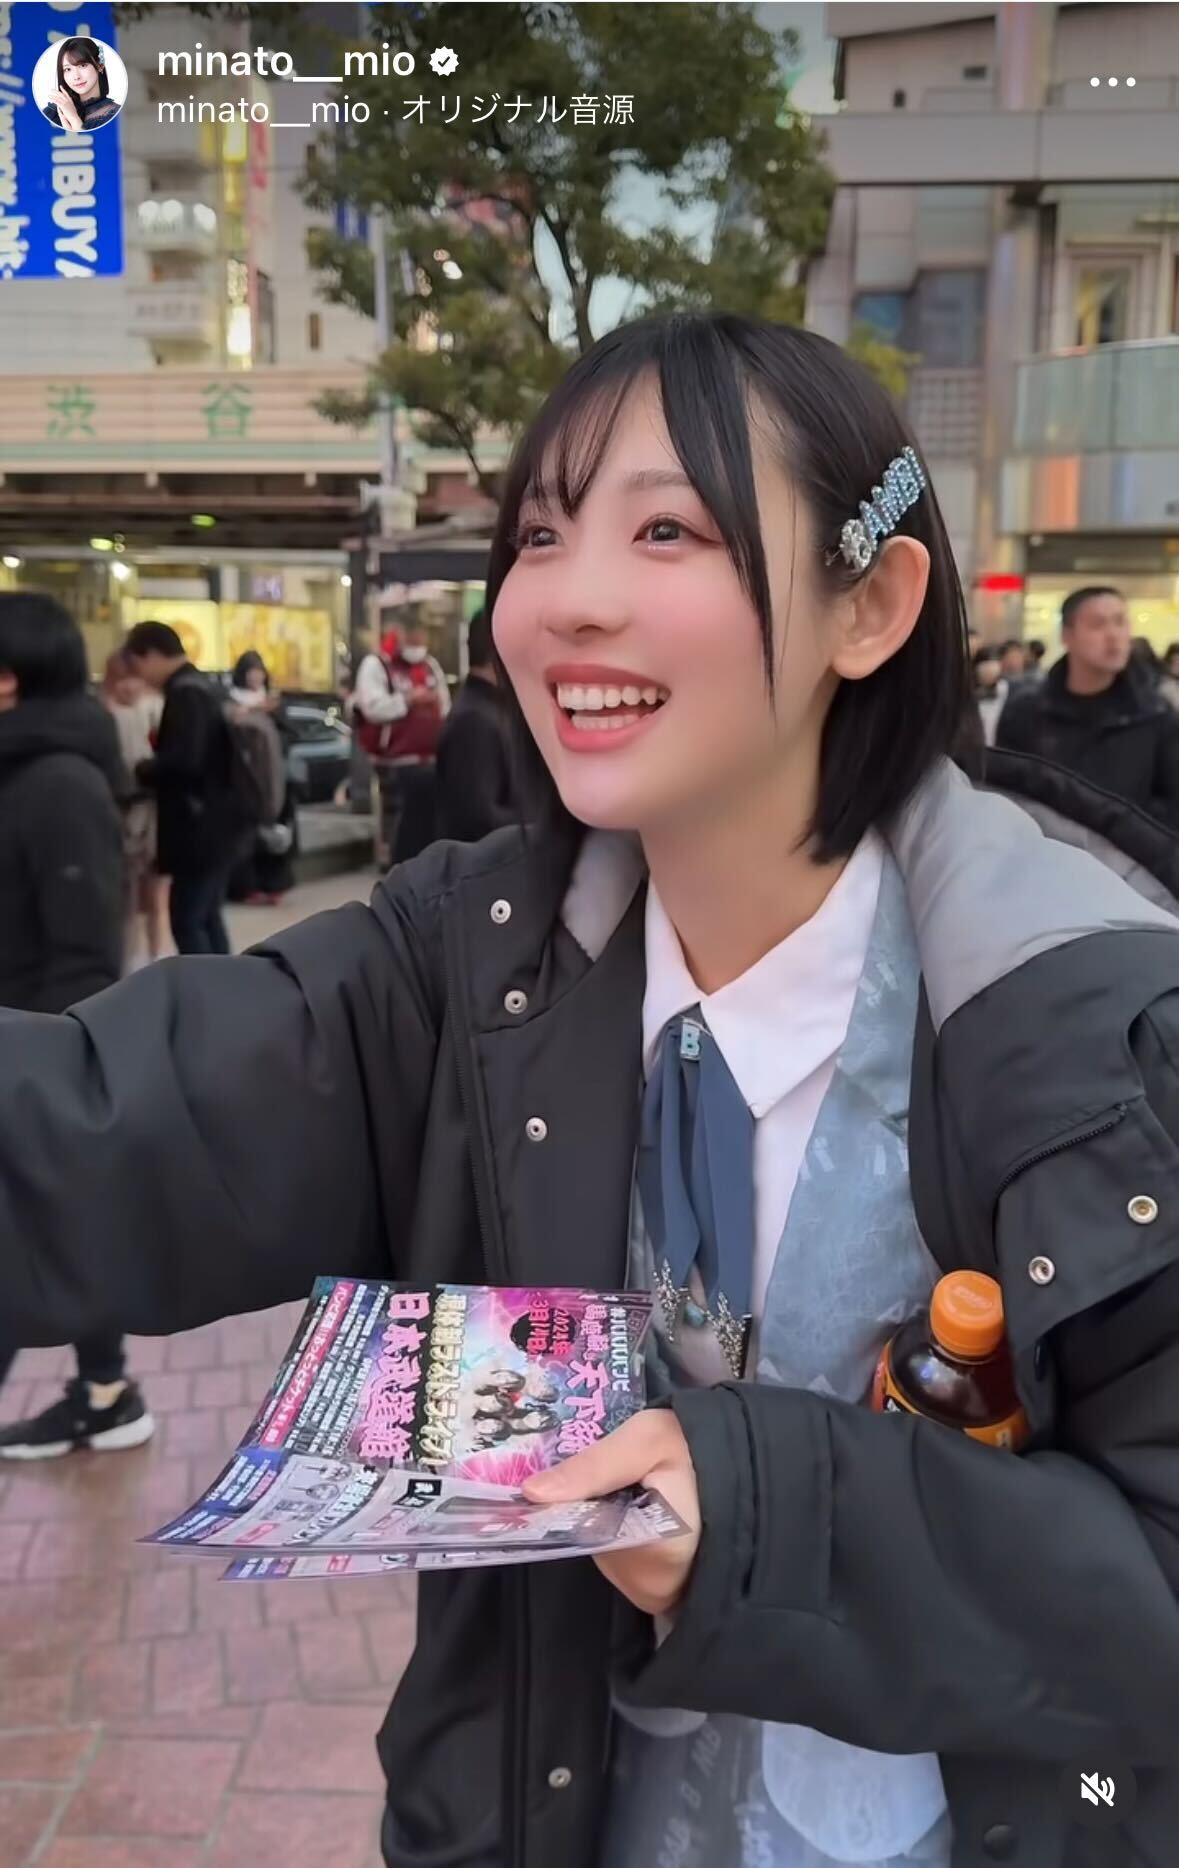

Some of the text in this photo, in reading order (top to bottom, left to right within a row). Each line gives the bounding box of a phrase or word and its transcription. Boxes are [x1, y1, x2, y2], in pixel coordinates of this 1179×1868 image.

[358, 1291, 431, 1459] 日本武道館
